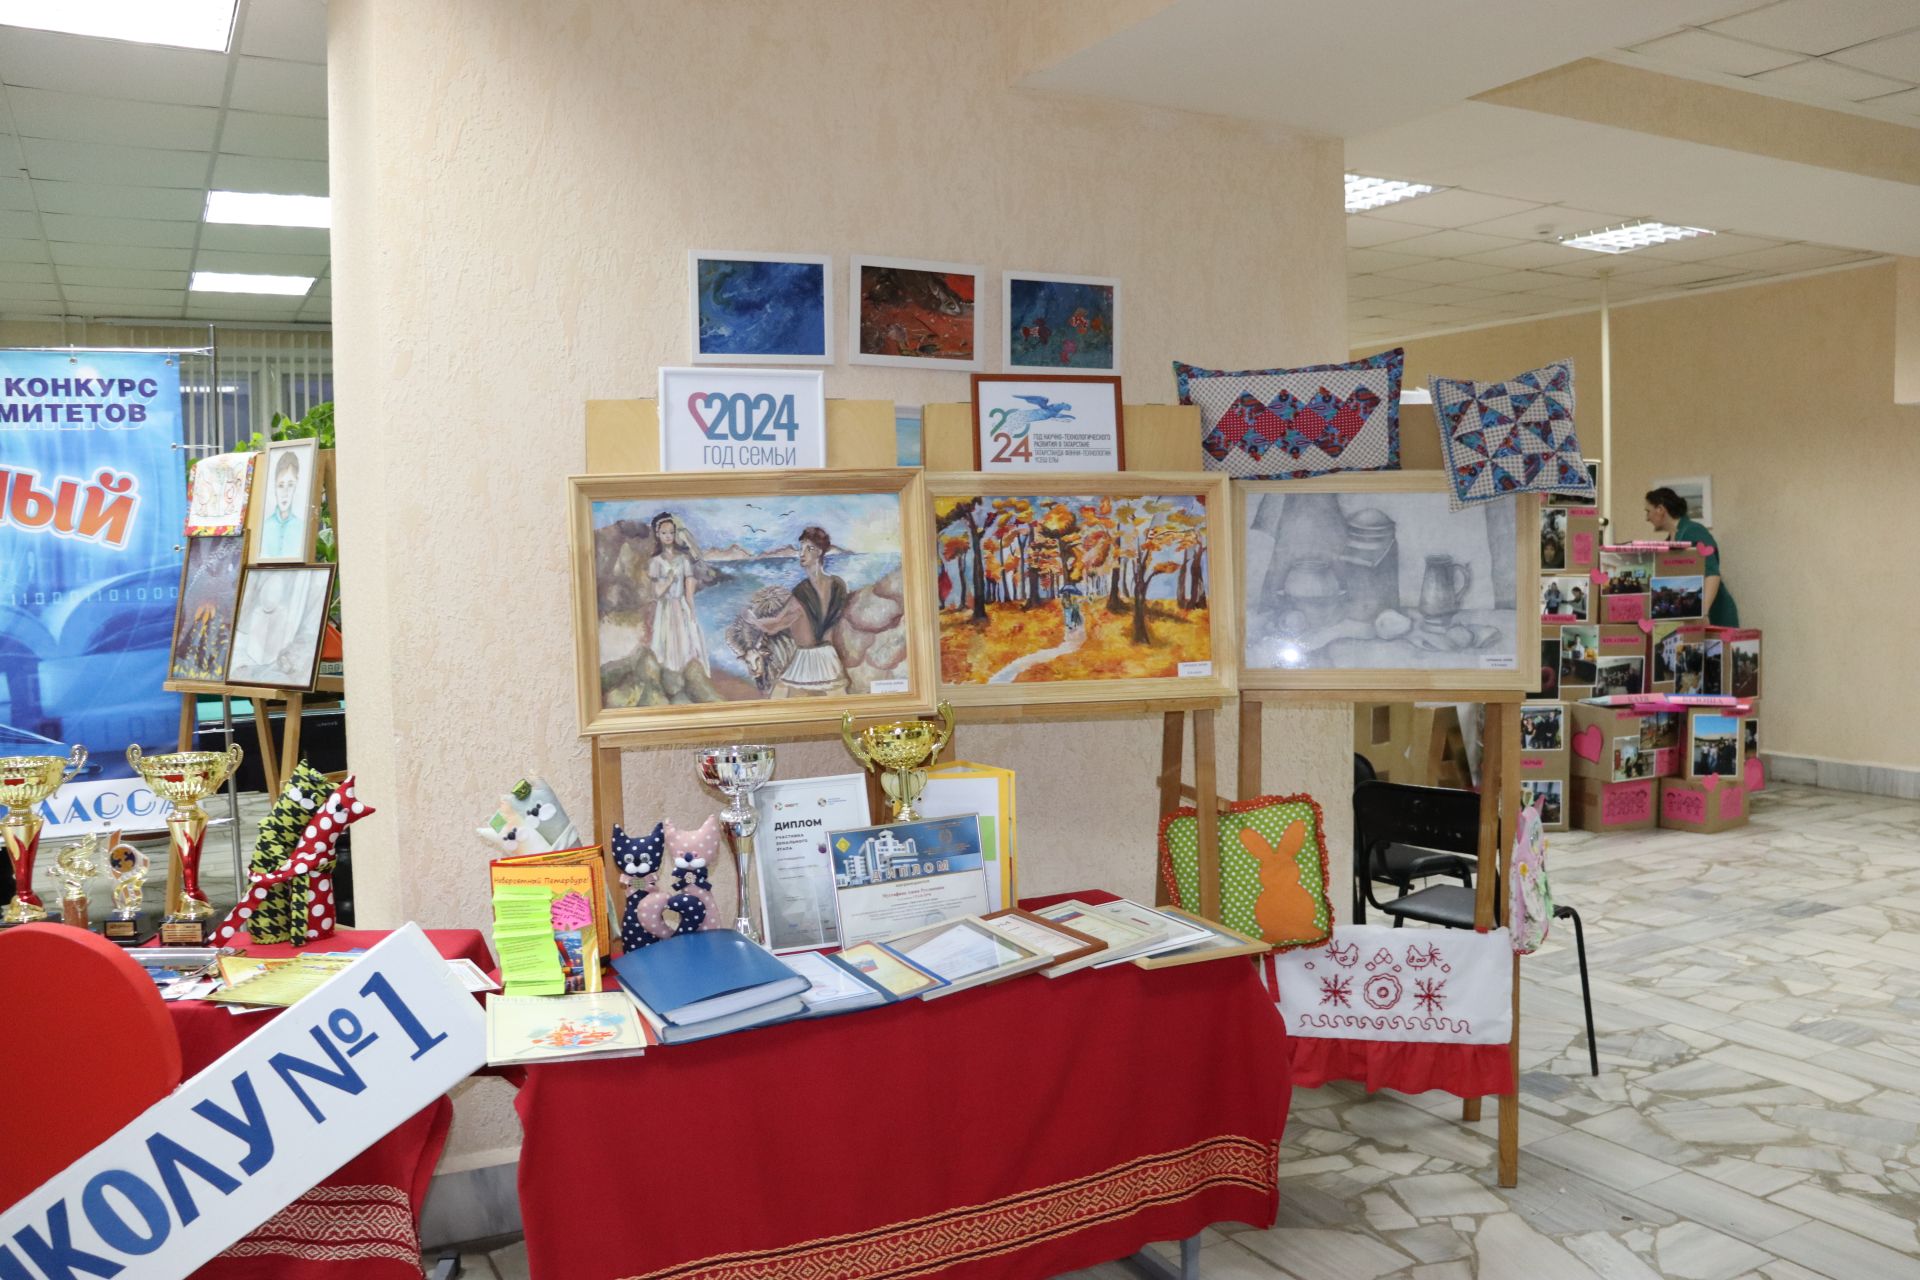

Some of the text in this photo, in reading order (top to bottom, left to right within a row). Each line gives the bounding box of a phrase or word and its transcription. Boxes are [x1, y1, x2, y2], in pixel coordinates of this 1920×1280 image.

[4, 377, 158, 397] КОНКУРС
[704, 391, 799, 442] 2024
[774, 818, 822, 832] ДИПЛОМ
[870, 859, 949, 882] ДИПЛОМ
